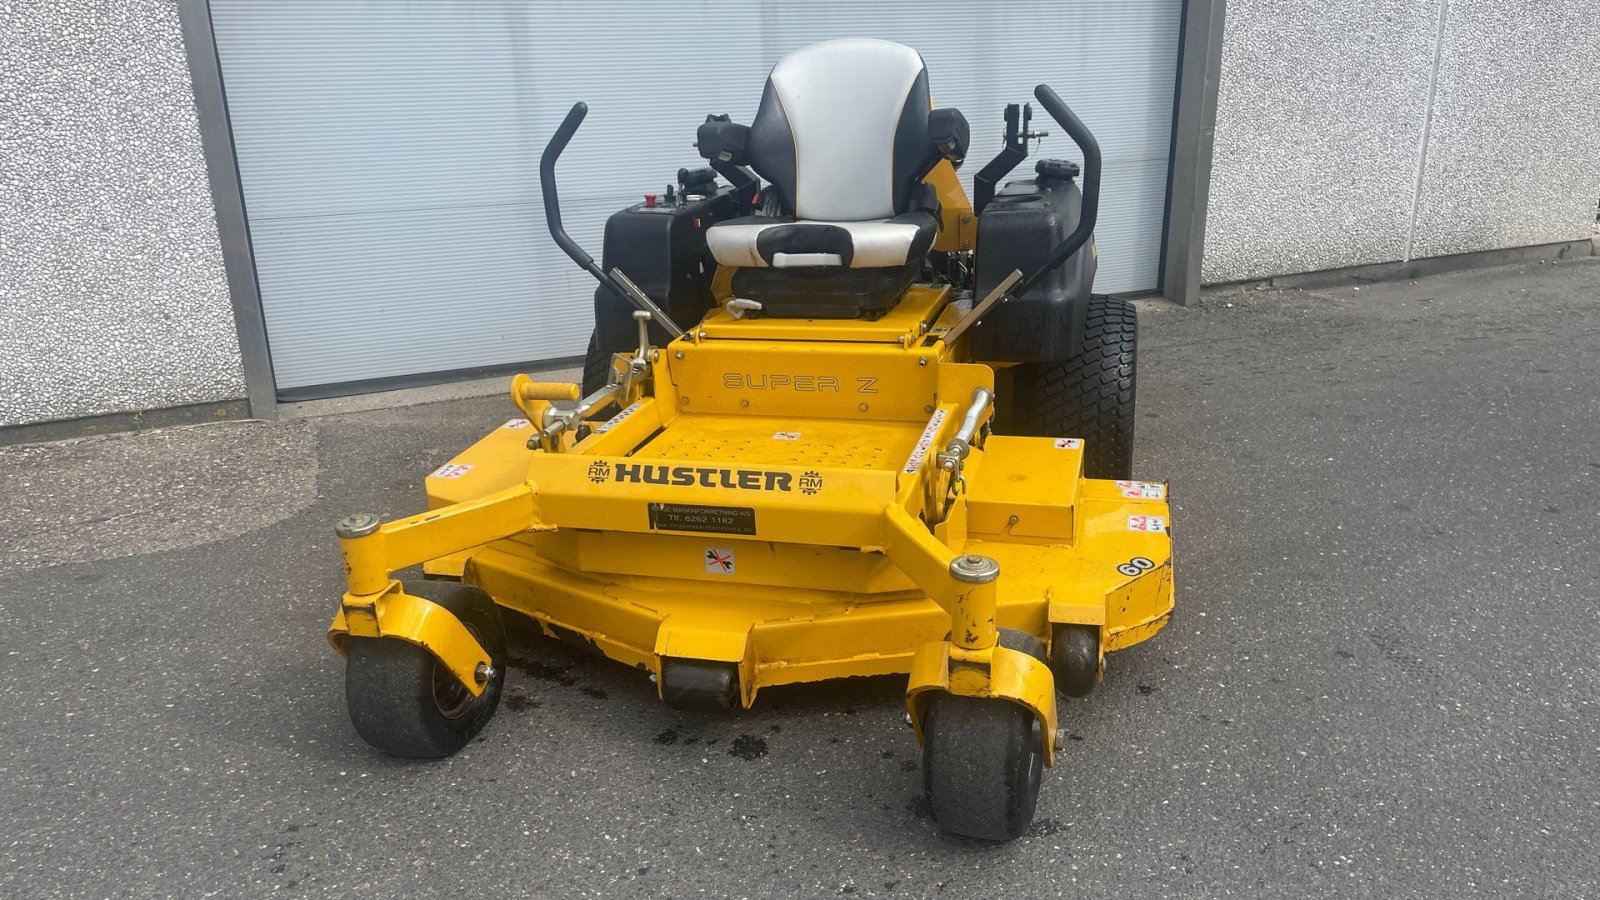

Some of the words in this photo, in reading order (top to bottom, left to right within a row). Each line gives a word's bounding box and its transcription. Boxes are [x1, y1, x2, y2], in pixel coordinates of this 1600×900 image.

[723, 373, 840, 393] SUPER
[857, 377, 879, 393] Z
[615, 463, 792, 492] HUSTLER
[685, 515, 708, 523] 6262
[711, 517, 734, 525] 1182
[1117, 556, 1155, 576] 60
